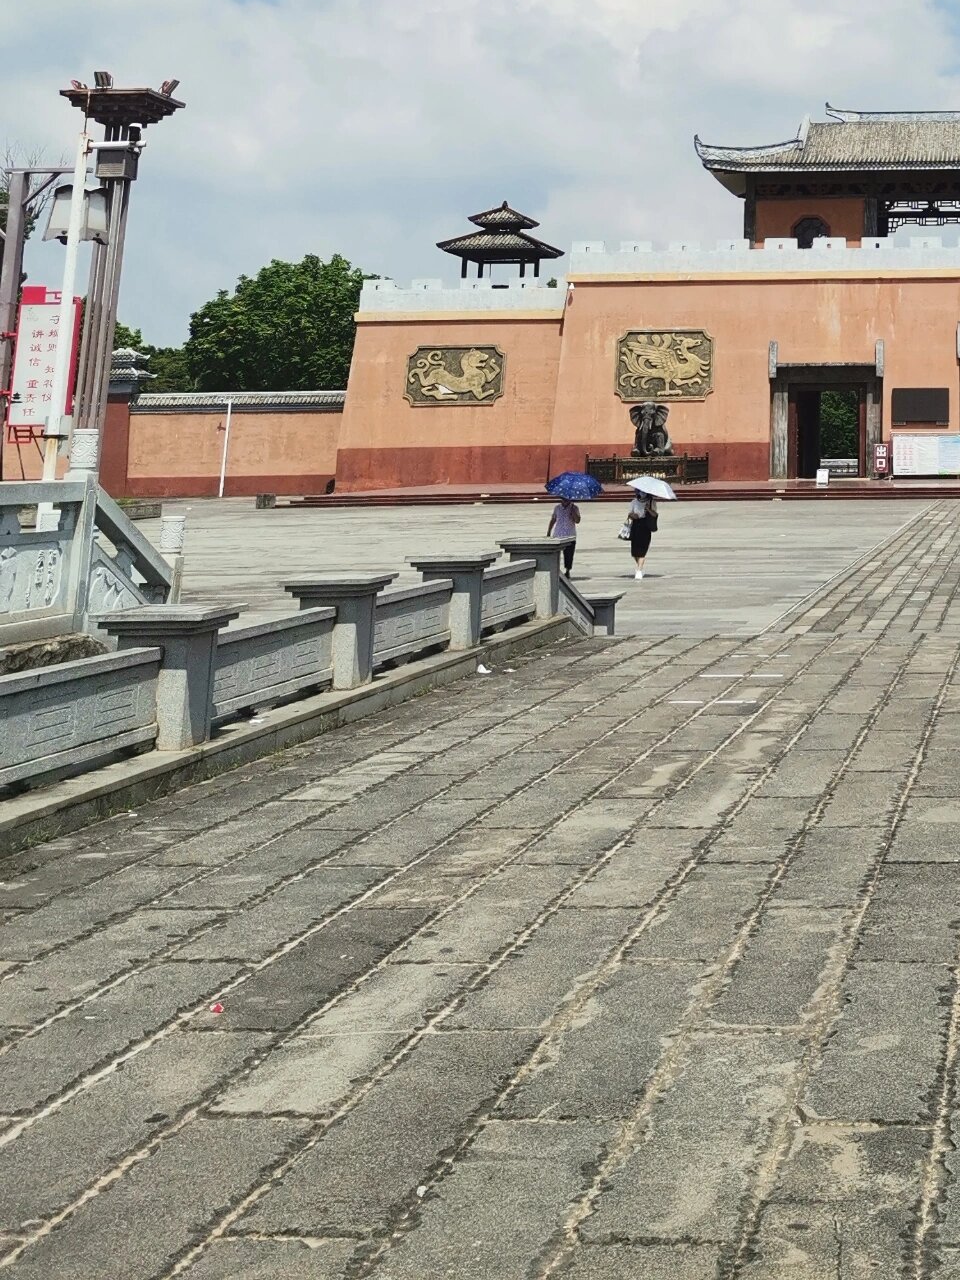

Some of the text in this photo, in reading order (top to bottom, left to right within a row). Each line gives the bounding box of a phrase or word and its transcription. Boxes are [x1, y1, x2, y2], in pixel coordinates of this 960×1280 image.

[29, 329, 44, 367] 讲诚信
[23, 380, 38, 416] 重责任
[876, 445, 886, 468] 出口
